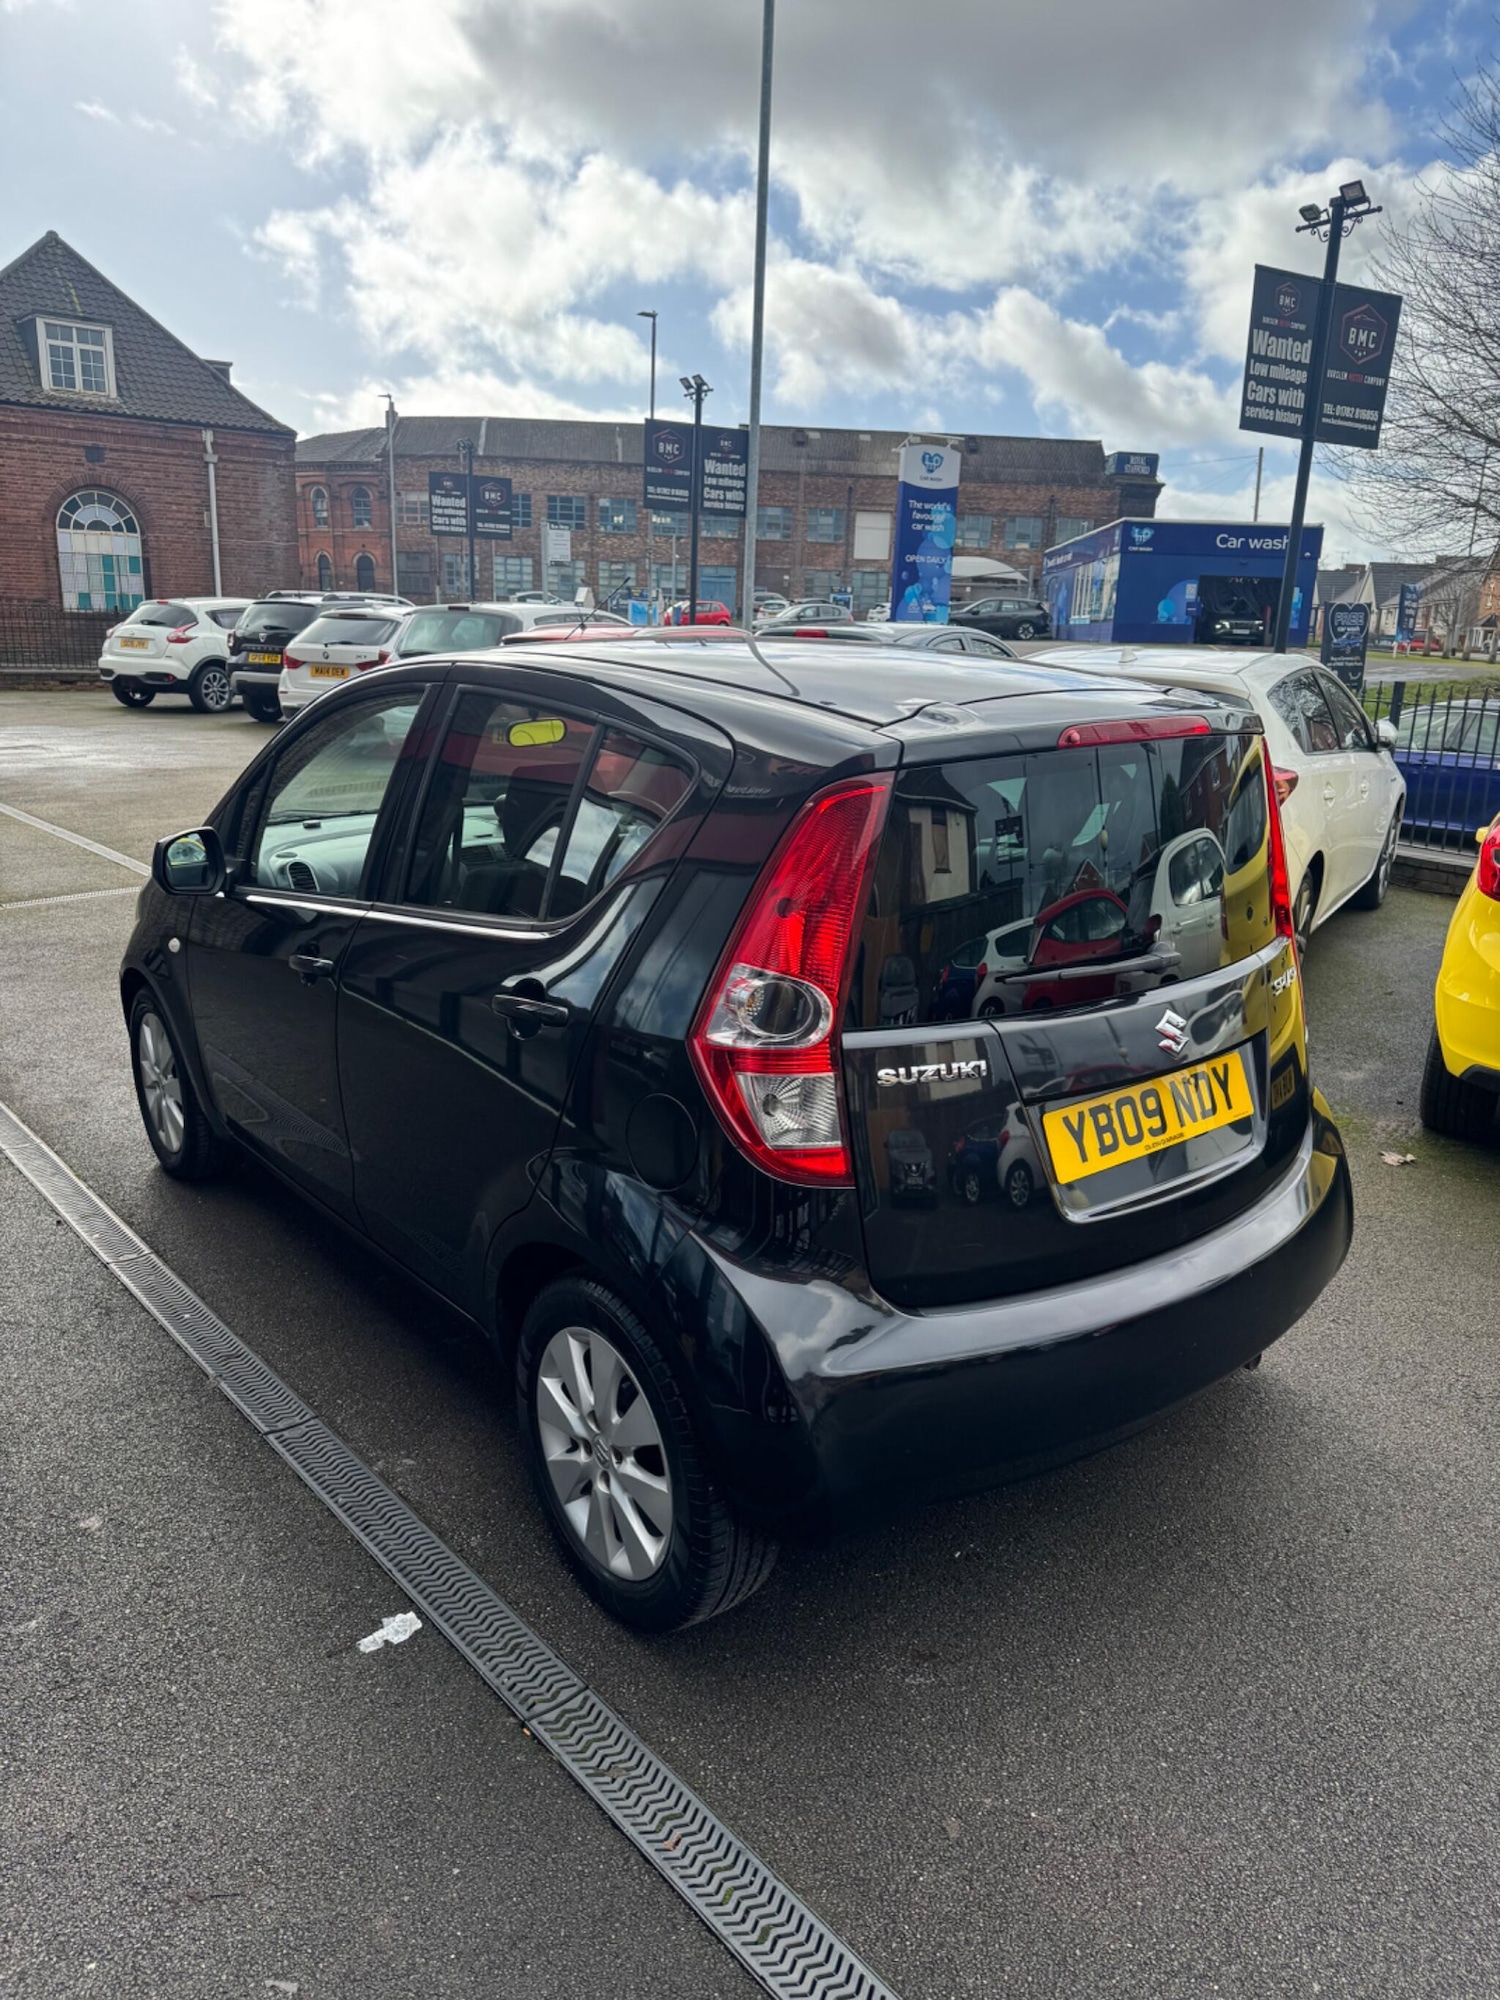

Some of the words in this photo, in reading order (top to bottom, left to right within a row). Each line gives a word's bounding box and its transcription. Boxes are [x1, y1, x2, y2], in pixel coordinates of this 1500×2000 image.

[1279, 294, 1296, 308] BMC
[1348, 328, 1377, 348] BMC
[1252, 329, 1312, 364] Wanted
[1250, 358, 1269, 377] Low
[1270, 364, 1308, 384] mileage
[1364, 374, 1386, 387] COMPANY
[1247, 380, 1276, 404] Cars
[1278, 387, 1305, 408] with
[1245, 406, 1274, 420] service
[1276, 408, 1303, 426] history
[1336, 405, 1354, 418] 01782
[658, 442, 680, 454] BMC
[704, 459, 746, 477] Wanted
[704, 475, 717, 485] Low
[718, 478, 744, 488] mileage
[484, 492, 502, 500] BMC
[704, 487, 724, 500] Cars
[725, 490, 745, 501] with
[431, 495, 466, 508] Wanted
[909, 499, 923, 509] The
[924, 502, 951, 510] world's
[432, 515, 449, 524] Cars
[450, 516, 466, 526] with
[925, 524, 944, 532] wash
[1216, 533, 1245, 549] Car
[905, 554, 926, 562] OPEN
[927, 555, 946, 564] DAILY
[876, 1060, 988, 1089] SUZUKI
[1062, 1086, 1168, 1164] YB09
[1171, 1062, 1234, 1129] NDY
